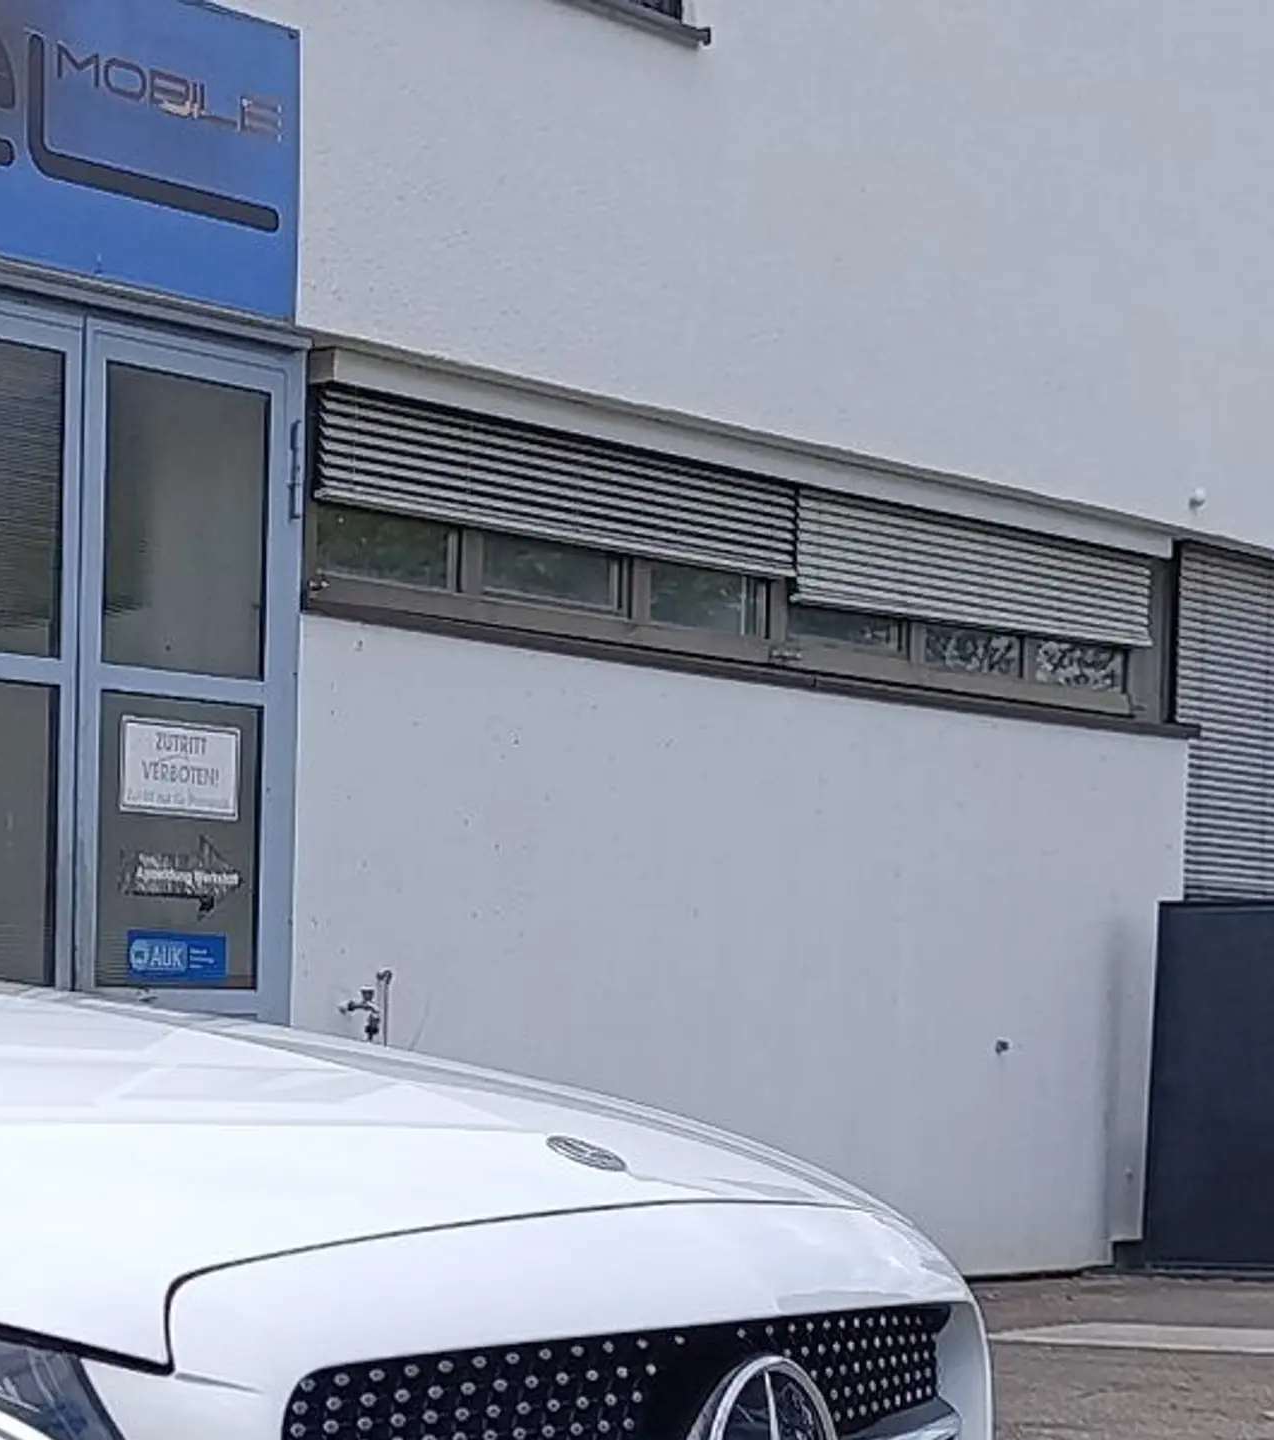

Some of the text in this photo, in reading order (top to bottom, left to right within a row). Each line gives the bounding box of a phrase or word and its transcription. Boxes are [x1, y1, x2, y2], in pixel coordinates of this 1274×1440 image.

[56, 40, 282, 145] MOBILE
[155, 731, 208, 756] ZUTRITT
[141, 759, 220, 789] VERBOTEN!
